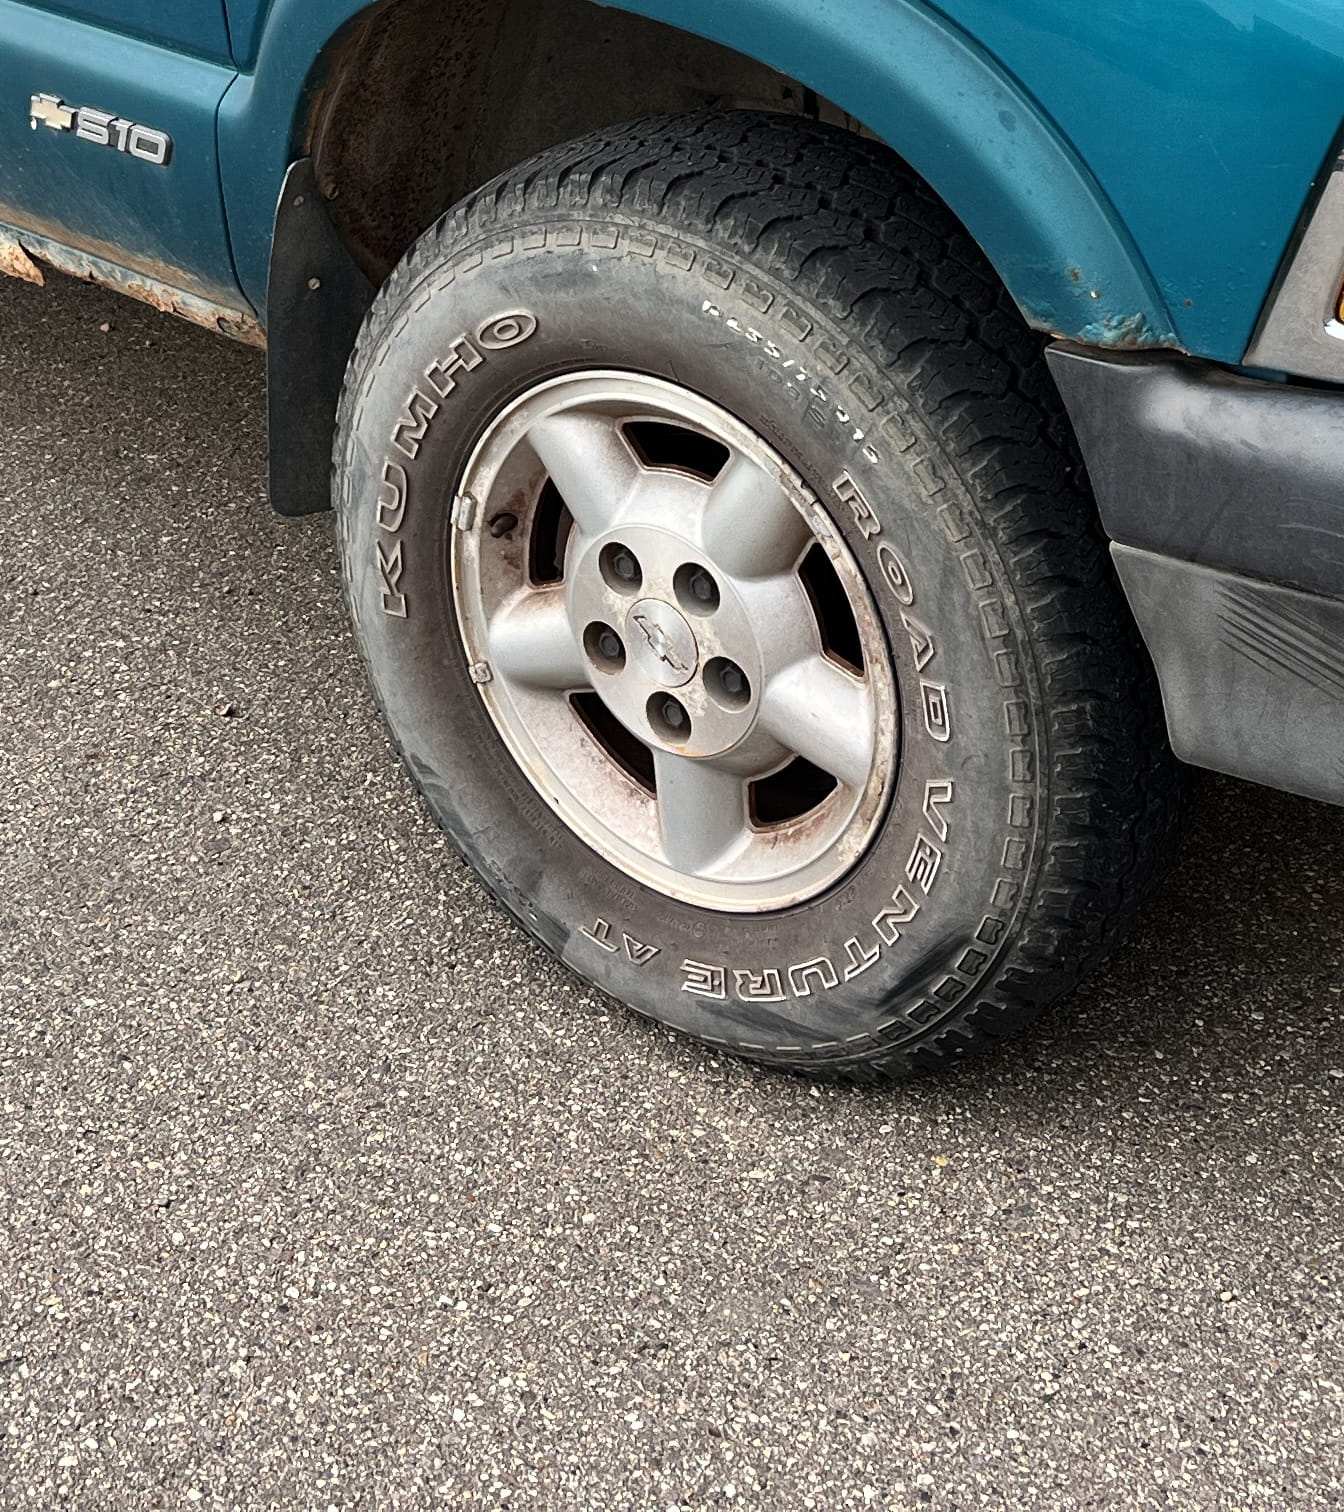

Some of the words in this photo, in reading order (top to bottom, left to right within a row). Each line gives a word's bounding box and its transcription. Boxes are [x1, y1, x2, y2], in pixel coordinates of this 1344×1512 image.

[75, 105, 173, 166] S10
[375, 307, 538, 619] KUMHO
[832, 469, 952, 743] ROAD
[577, 917, 660, 967] AT
[678, 778, 954, 1003] VENTURE
